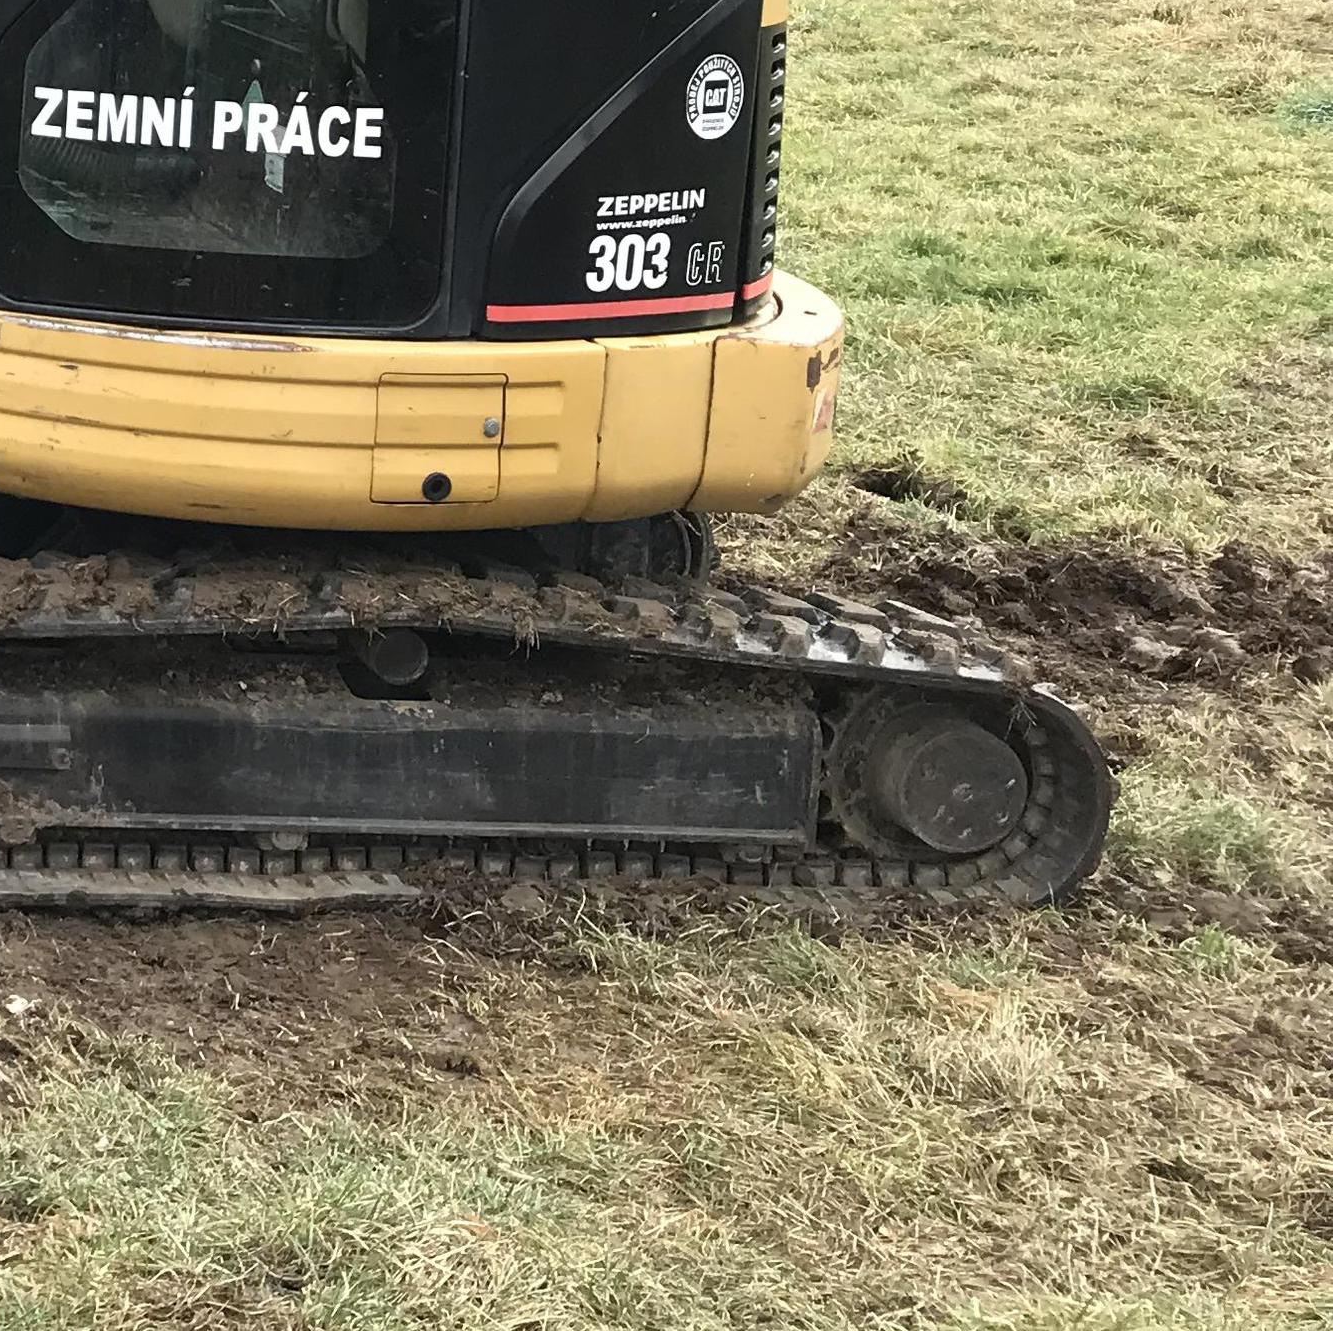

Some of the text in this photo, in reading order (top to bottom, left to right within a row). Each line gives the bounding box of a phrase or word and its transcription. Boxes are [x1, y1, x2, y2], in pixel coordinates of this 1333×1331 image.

[705, 88, 727, 107] CAT
[31, 86, 385, 159] ZEMNÍ PRÁCE
[597, 188, 706, 217] ZEPPELIN
[586, 232, 671, 292] 303
